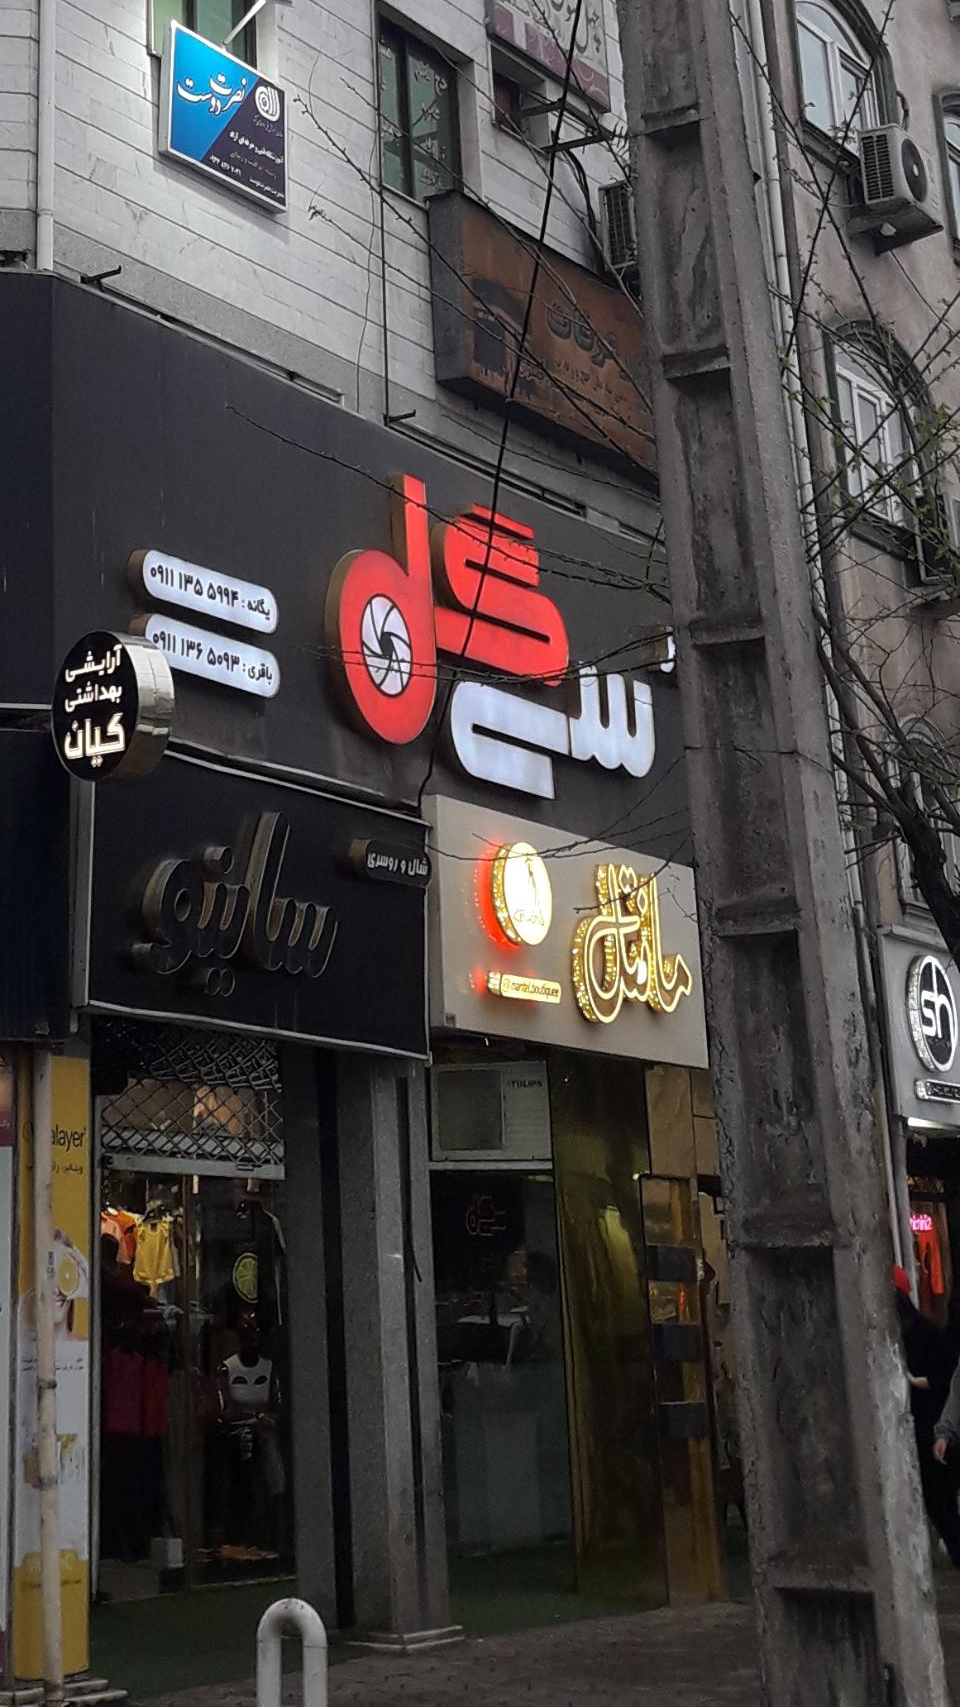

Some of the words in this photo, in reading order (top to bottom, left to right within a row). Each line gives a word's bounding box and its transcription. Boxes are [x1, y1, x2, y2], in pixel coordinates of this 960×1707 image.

[64, 643, 123, 683] آرایشی
[64, 680, 123, 713] بهداشتی
[63, 712, 126, 768] کیان
